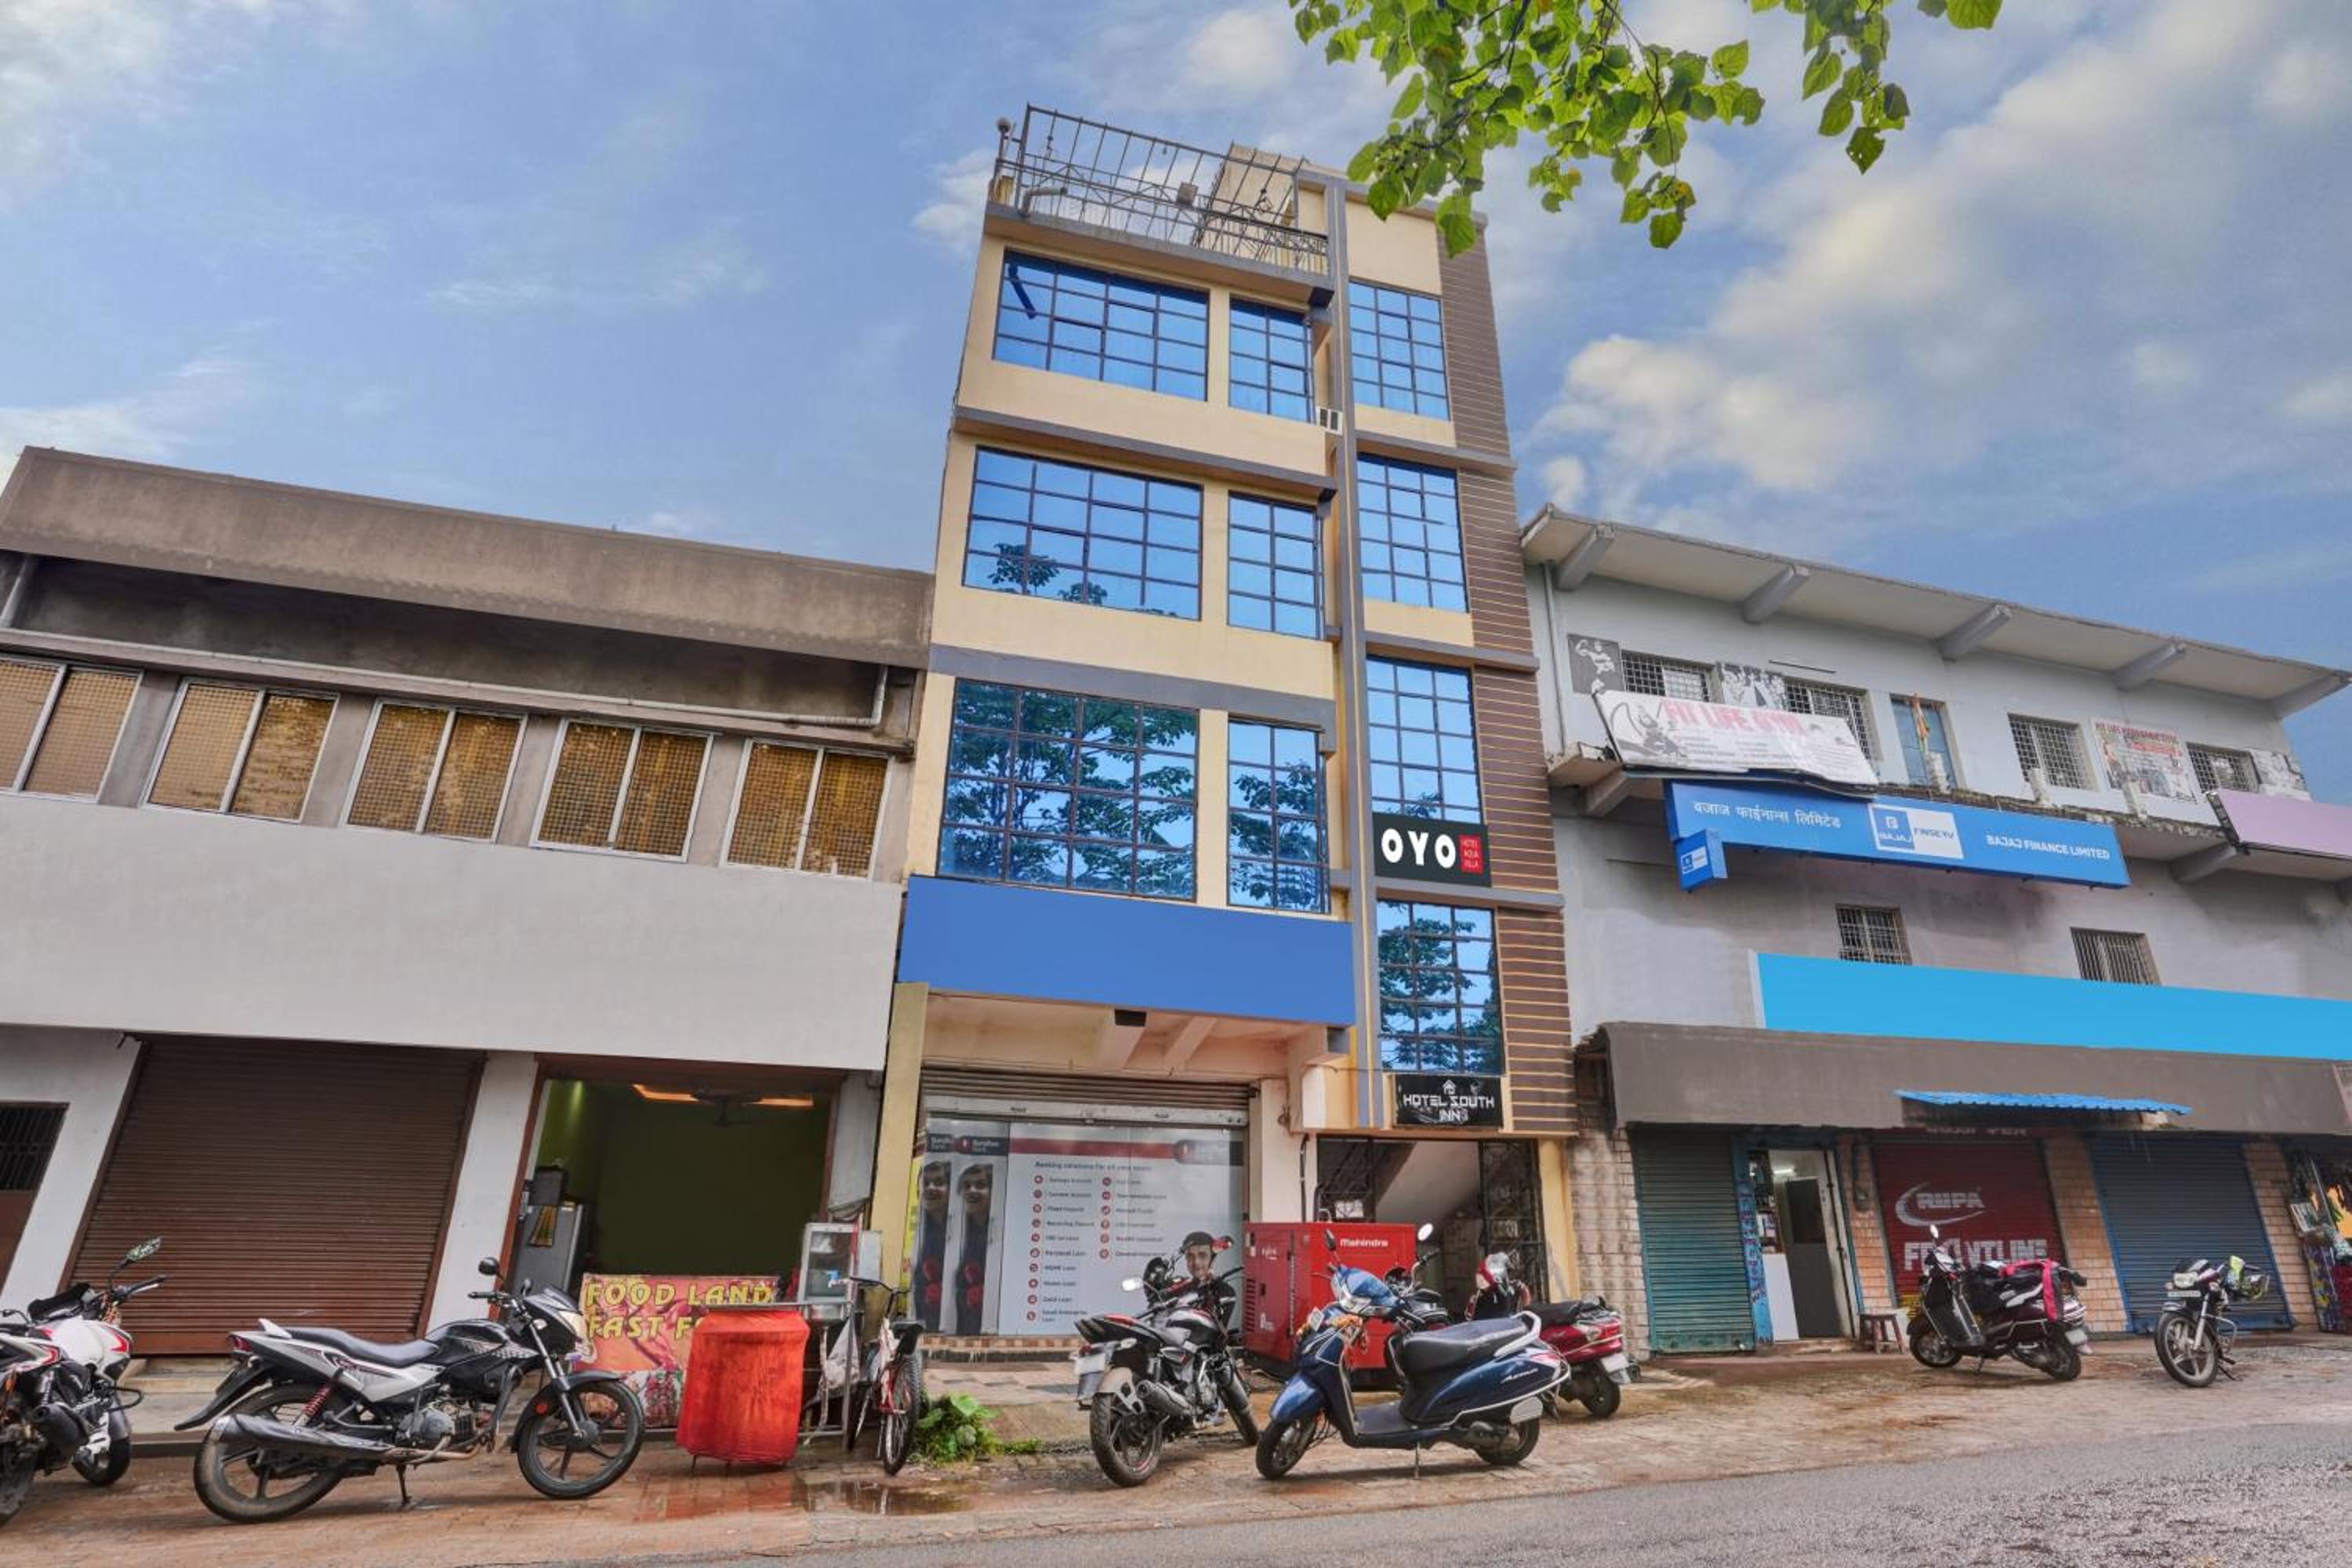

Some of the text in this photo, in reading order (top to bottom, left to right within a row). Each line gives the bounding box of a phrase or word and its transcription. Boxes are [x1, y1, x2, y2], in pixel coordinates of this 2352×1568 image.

[1381, 828, 1456, 869] OYO
[1986, 834, 2110, 860] BAJAJ FINANCE LIMITED
[1403, 1094, 1495, 1109] HOTEL SOUTH
[1439, 1109, 1461, 1122] INN
[1916, 1191, 1985, 1210] RUPA
[586, 1283, 774, 1306] FOOD LAND
[588, 1316, 666, 1339] FAST
